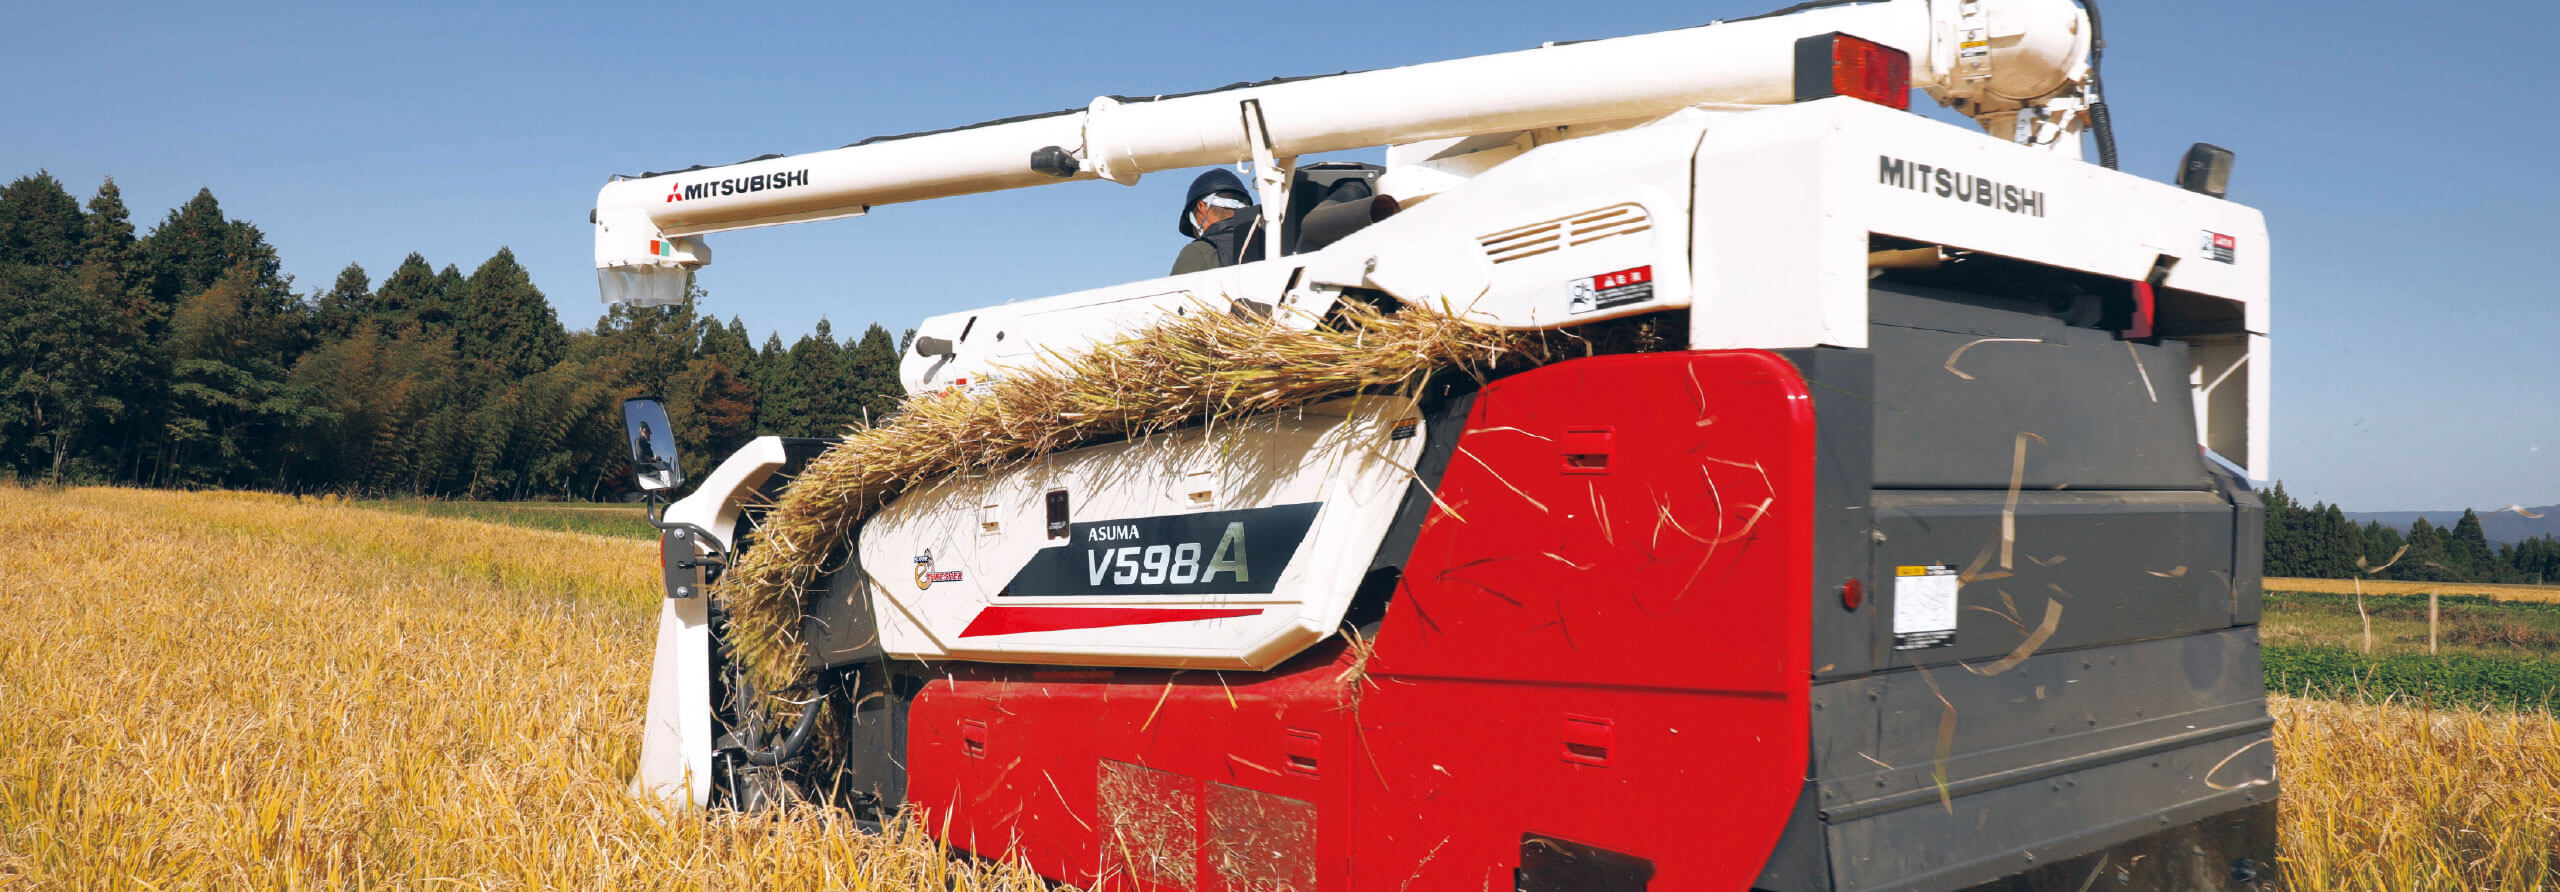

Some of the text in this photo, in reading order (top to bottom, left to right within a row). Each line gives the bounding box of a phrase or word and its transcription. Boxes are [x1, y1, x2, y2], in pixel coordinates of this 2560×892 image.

[685, 169, 808, 200] MITSUBISHI
[1879, 155, 2044, 218] MITSUBISHI
[1088, 525, 1140, 542] ASUMA
